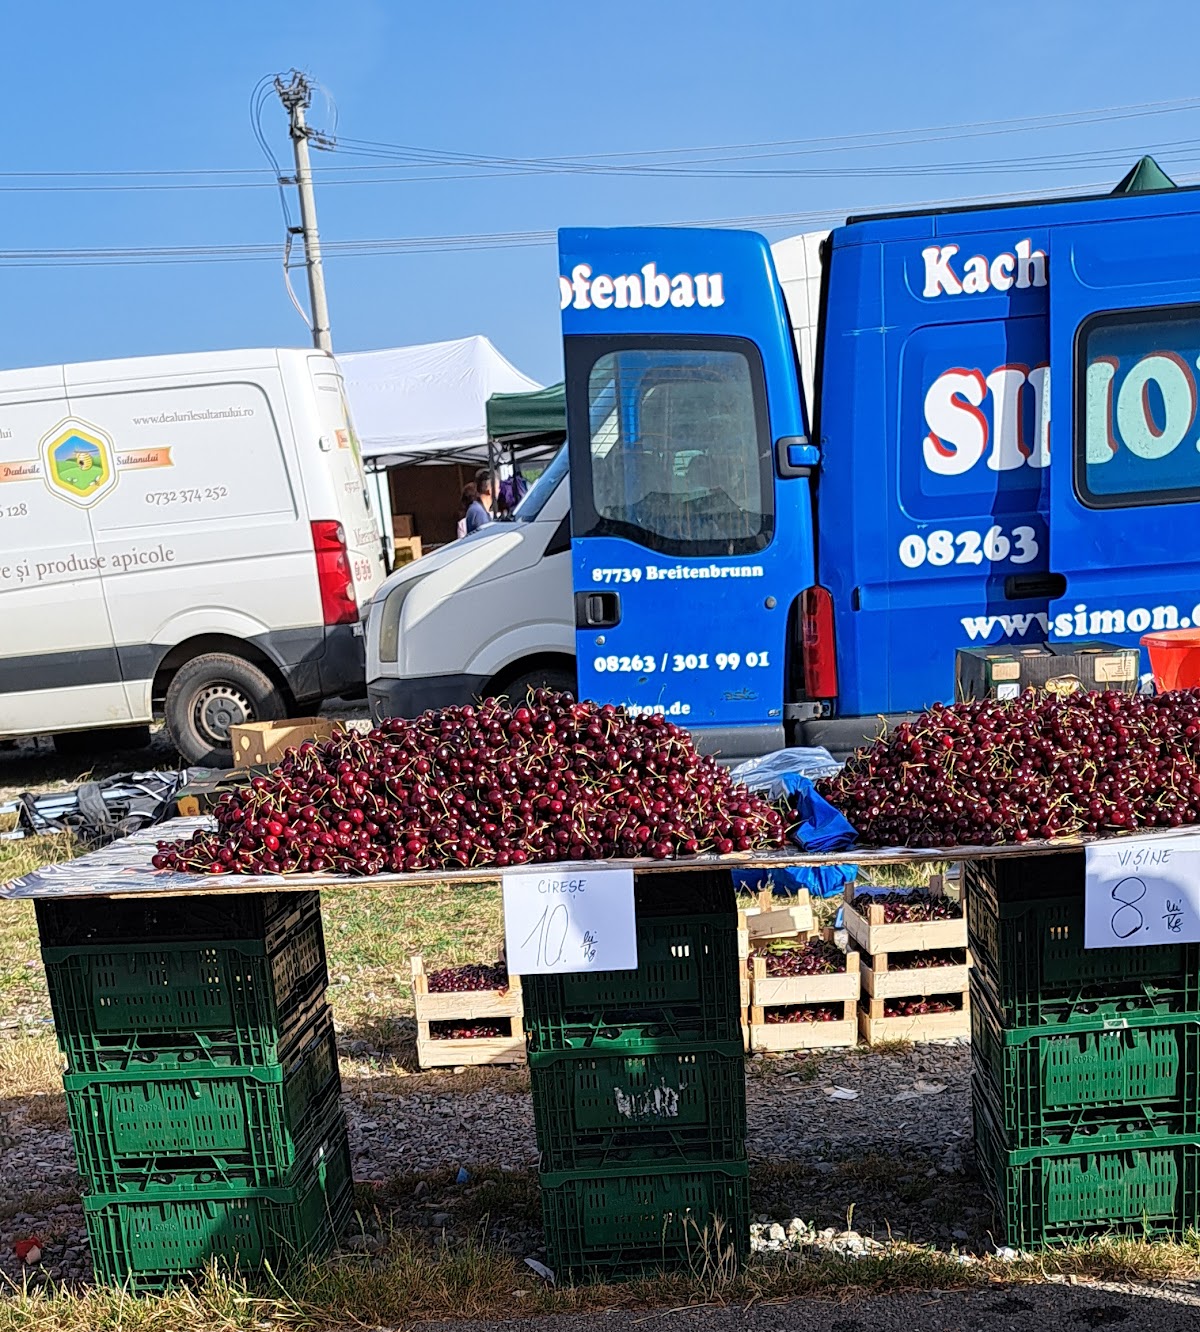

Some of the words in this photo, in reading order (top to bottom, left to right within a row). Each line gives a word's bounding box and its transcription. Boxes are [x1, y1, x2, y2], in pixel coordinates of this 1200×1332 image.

[922, 238, 1047, 297] Kach
[132, 406, 254, 425] www.dealurilesultanului.ro
[116, 453, 159, 466] Sultanului
[145, 491, 177, 505] 0732
[180, 489, 202, 503] 374
[205, 486, 228, 500] 252
[7, 503, 28, 517] 128
[899, 525, 1039, 568] 08263
[16, 559, 30, 583] și
[36, 553, 107, 581] produse
[112, 544, 175, 572] apicole
[592, 568, 642, 583] 87739
[646, 564, 763, 581] Breitenbrunn
[594, 655, 656, 673] 08263
[660, 653, 669, 673] /
[672, 653, 709, 672] 301
[715, 652, 741, 671] 99
[745, 651, 770, 668] 01
